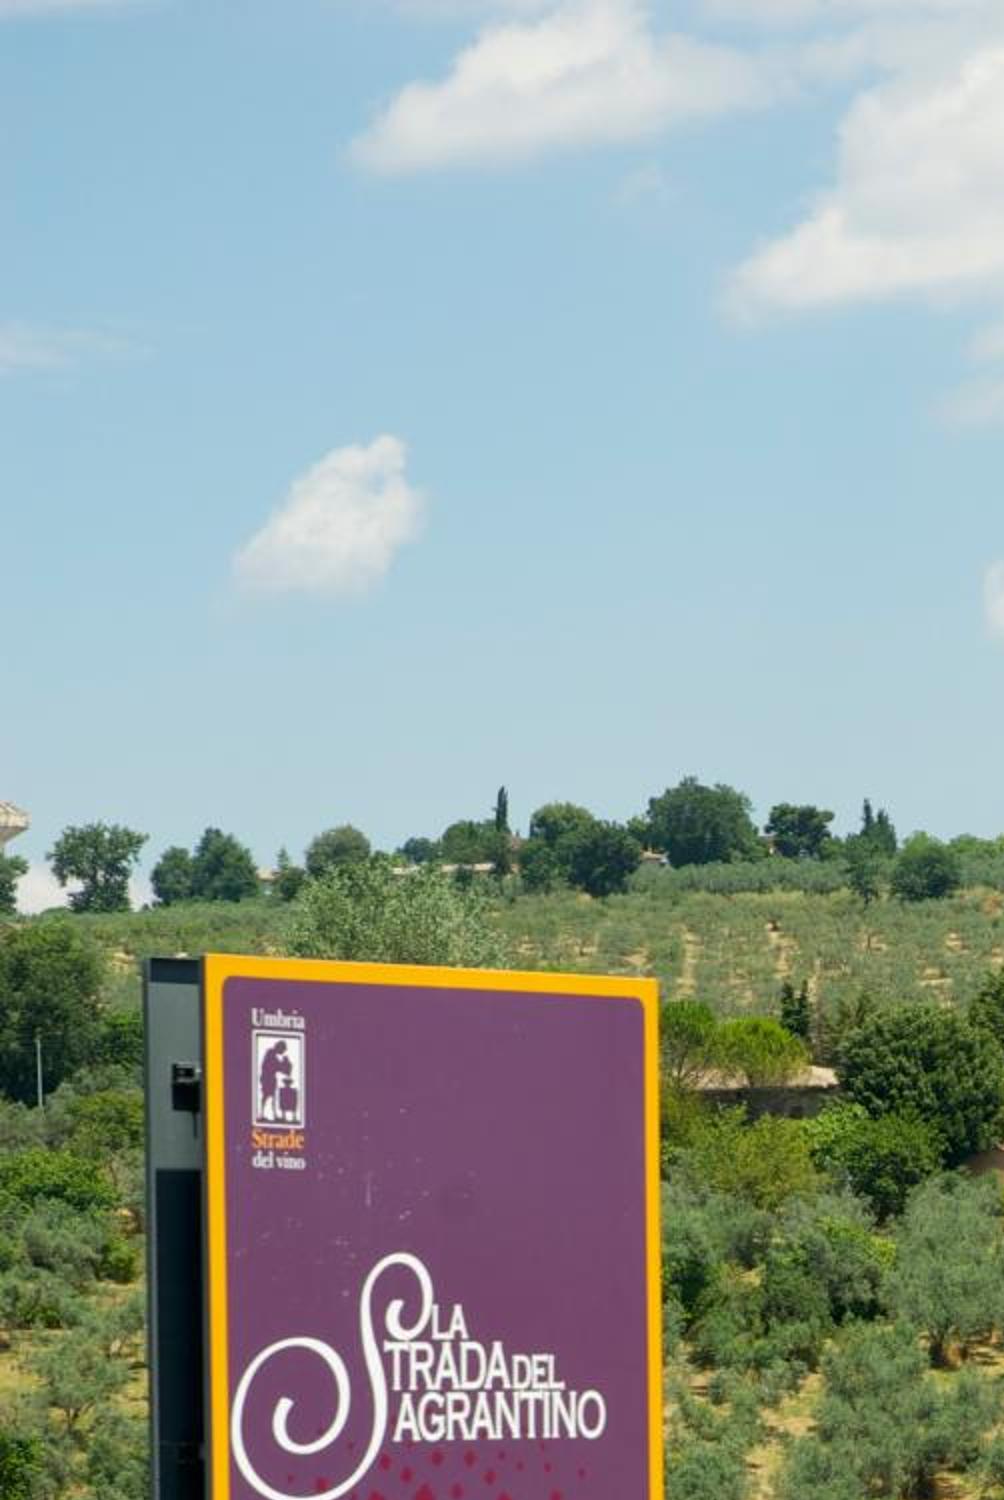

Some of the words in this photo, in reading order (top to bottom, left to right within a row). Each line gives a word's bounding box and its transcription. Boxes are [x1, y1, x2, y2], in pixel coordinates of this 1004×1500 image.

[251, 1008, 305, 1029] Umbria
[252, 1129, 305, 1149] Strade
[252, 1151, 274, 1169] del
[277, 1152, 306, 1169] vino
[431, 1304, 469, 1340] LA
[511, 1353, 565, 1390] DEL
[393, 1390, 606, 1442] AGRANTINO
